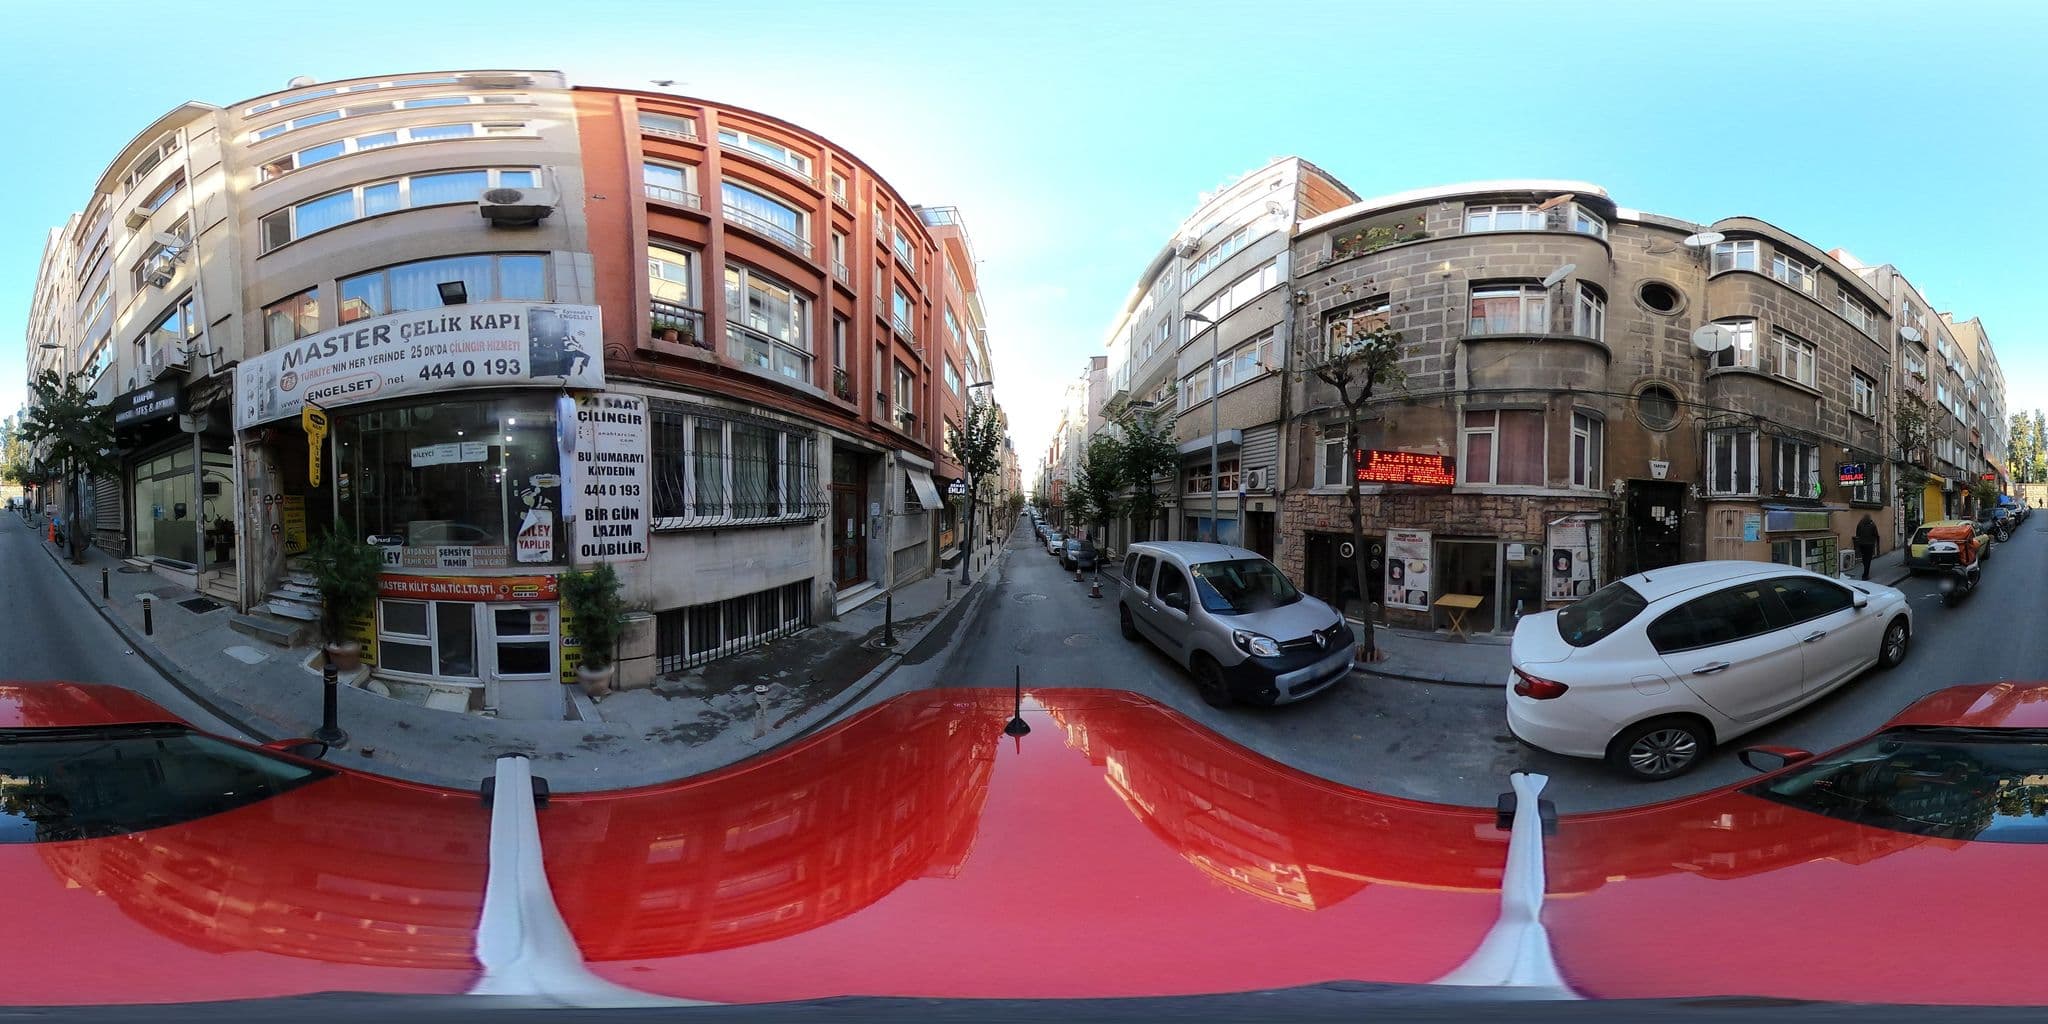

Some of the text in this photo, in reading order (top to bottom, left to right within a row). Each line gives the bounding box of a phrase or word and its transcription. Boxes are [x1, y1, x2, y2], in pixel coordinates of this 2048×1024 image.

[281, 314, 520, 372] MASTER ÇELİK KAPI
[349, 358, 366, 370] HER
[367, 350, 406, 366] YERİNDE
[411, 346, 422, 359] 25
[425, 346, 447, 357] DK'DA
[450, 341, 484, 358] ÇİLİNGİR
[487, 339, 520, 353] HİZMETİ
[307, 379, 373, 401] ENGELSET
[385, 376, 405, 386] .net
[419, 362, 456, 380] 444
[463, 360, 475, 376] 0
[483, 359, 521, 376] 193
[578, 410, 641, 425] ÇİLİNGİR
[578, 452, 644, 463] BU NUMARAYI
[588, 465, 635, 476] KAYDEDİN
[584, 484, 640, 496] 444 0 193
[585, 505, 639, 521] BİR GÜN
[593, 524, 632, 537] LAZIM
[439, 547, 471, 558] ŞEMSİYE
[582, 541, 645, 557] OLABİLİR.
[443, 558, 467, 567] TAMİR
[378, 580, 407, 591] MASTER
[409, 581, 428, 592] KİLİT
